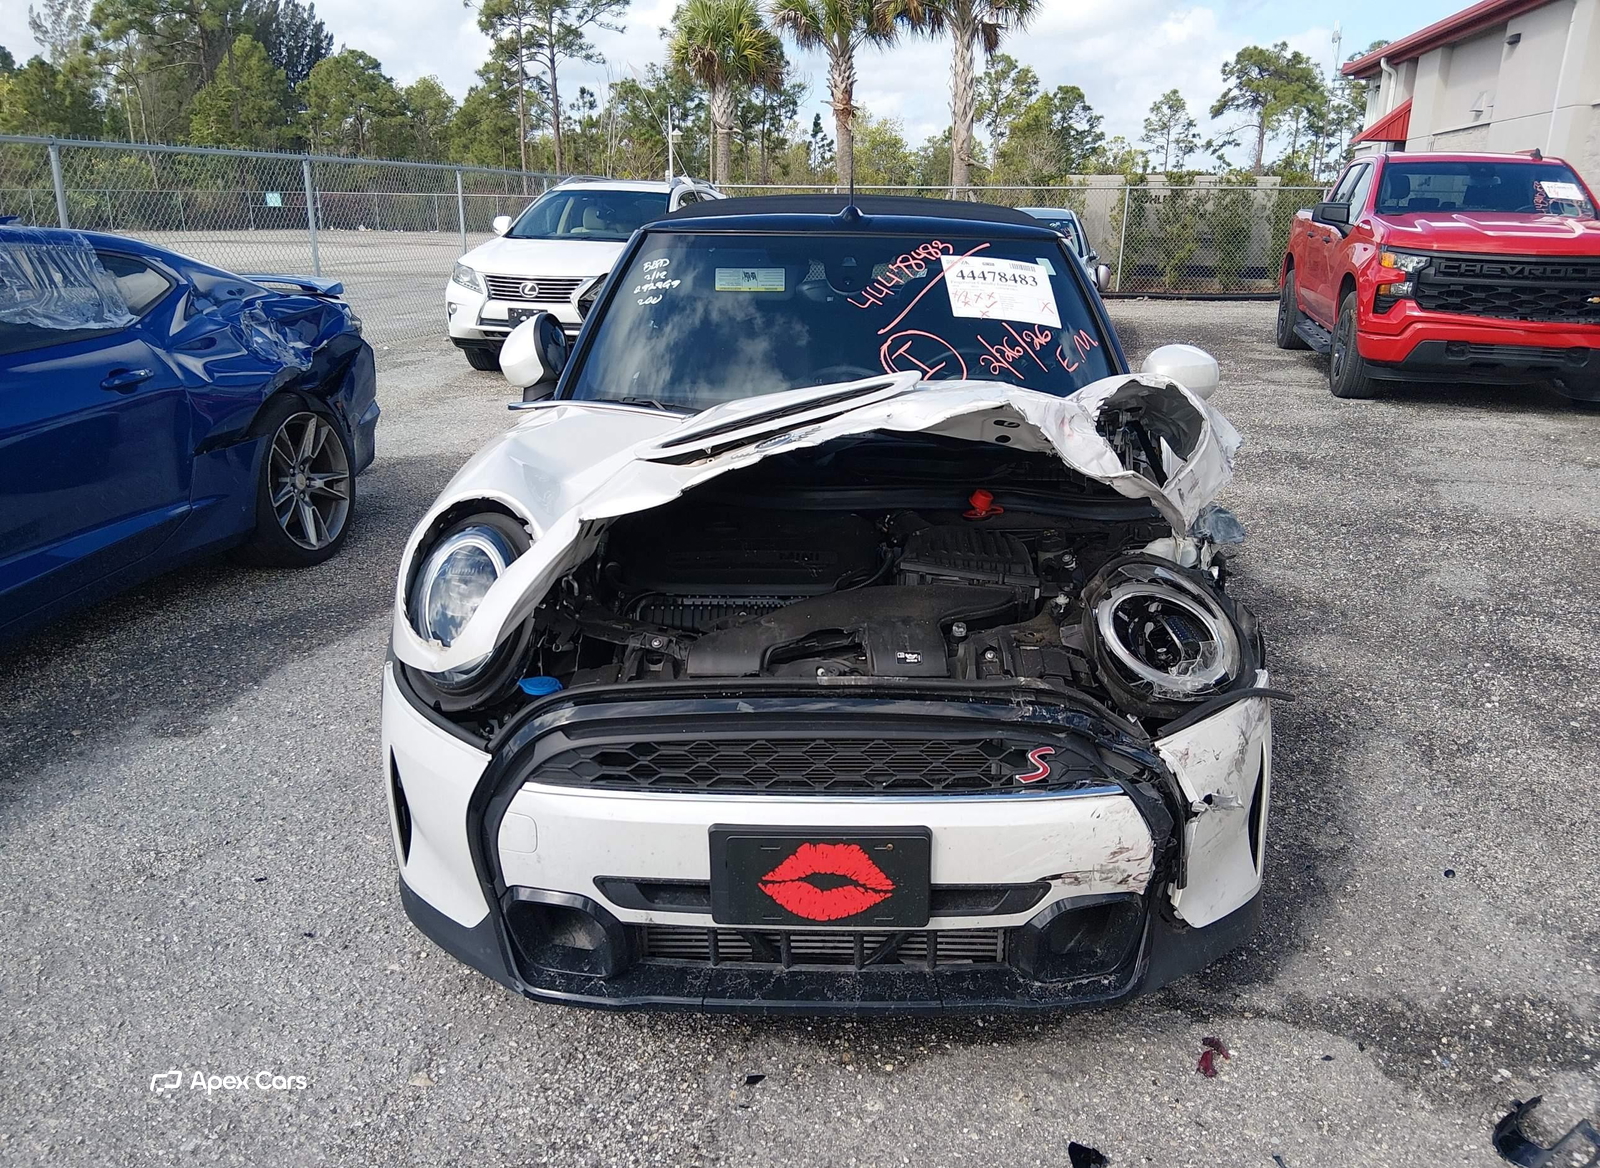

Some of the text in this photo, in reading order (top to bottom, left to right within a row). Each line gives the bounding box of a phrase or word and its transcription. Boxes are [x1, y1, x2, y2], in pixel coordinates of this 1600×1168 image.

[847, 240, 954, 308] 44478483
[956, 269, 1038, 287] 44478483
[1015, 746, 1056, 784] S
